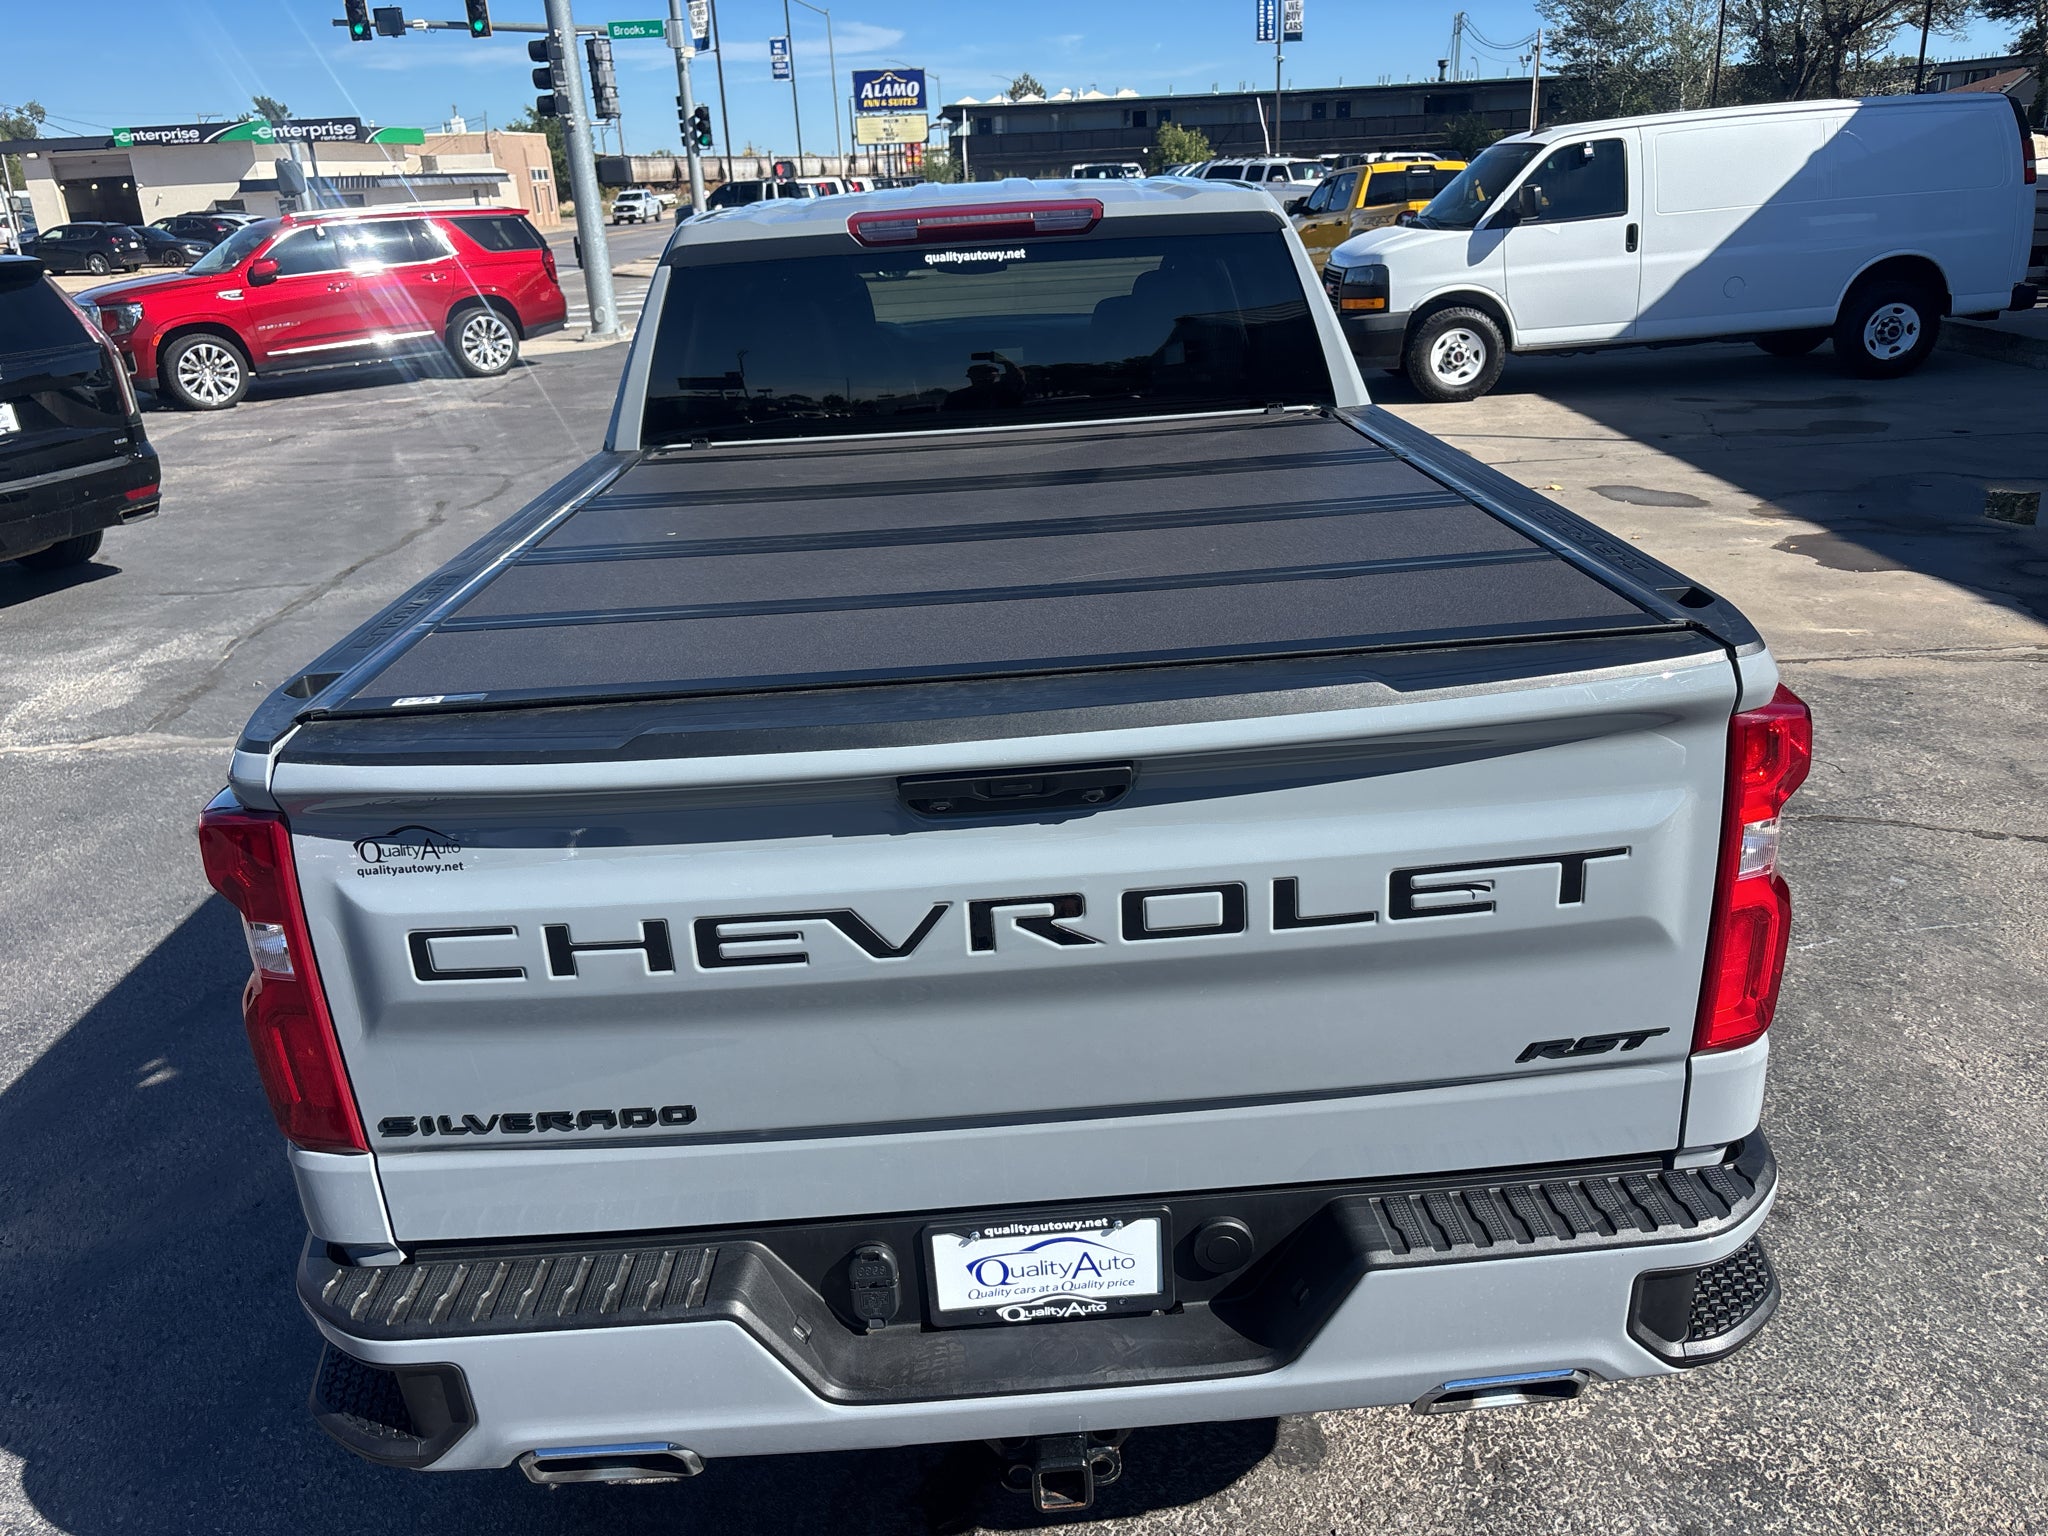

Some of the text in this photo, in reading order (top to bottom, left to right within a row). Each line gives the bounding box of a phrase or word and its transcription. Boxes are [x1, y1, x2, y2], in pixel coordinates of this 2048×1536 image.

[1286, 12, 1301, 21] BUY
[613, 25, 645, 36] Brooks
[1284, 21, 1303, 31] CARS
[861, 81, 920, 99] ALAMO
[863, 99, 880, 107] INN
[888, 97, 918, 106] SUITES
[114, 128, 200, 142] enterprise
[253, 122, 356, 139] enterprise
[925, 248, 1026, 265] qualityautowy.net
[357, 862, 464, 878] qualityautowy.net
[408, 845, 1630, 984] CHEVROLET
[1514, 1026, 1671, 1063] RST
[377, 1105, 697, 1137] SILVERADO
[984, 1217, 1108, 1237] qualityautowy.net
[968, 1289, 1011, 1300] Quality
[1014, 1287, 1036, 1295] cars
[1039, 1284, 1050, 1292] at
[1061, 1280, 1105, 1292] Quality
[1107, 1278, 1136, 1289] price
